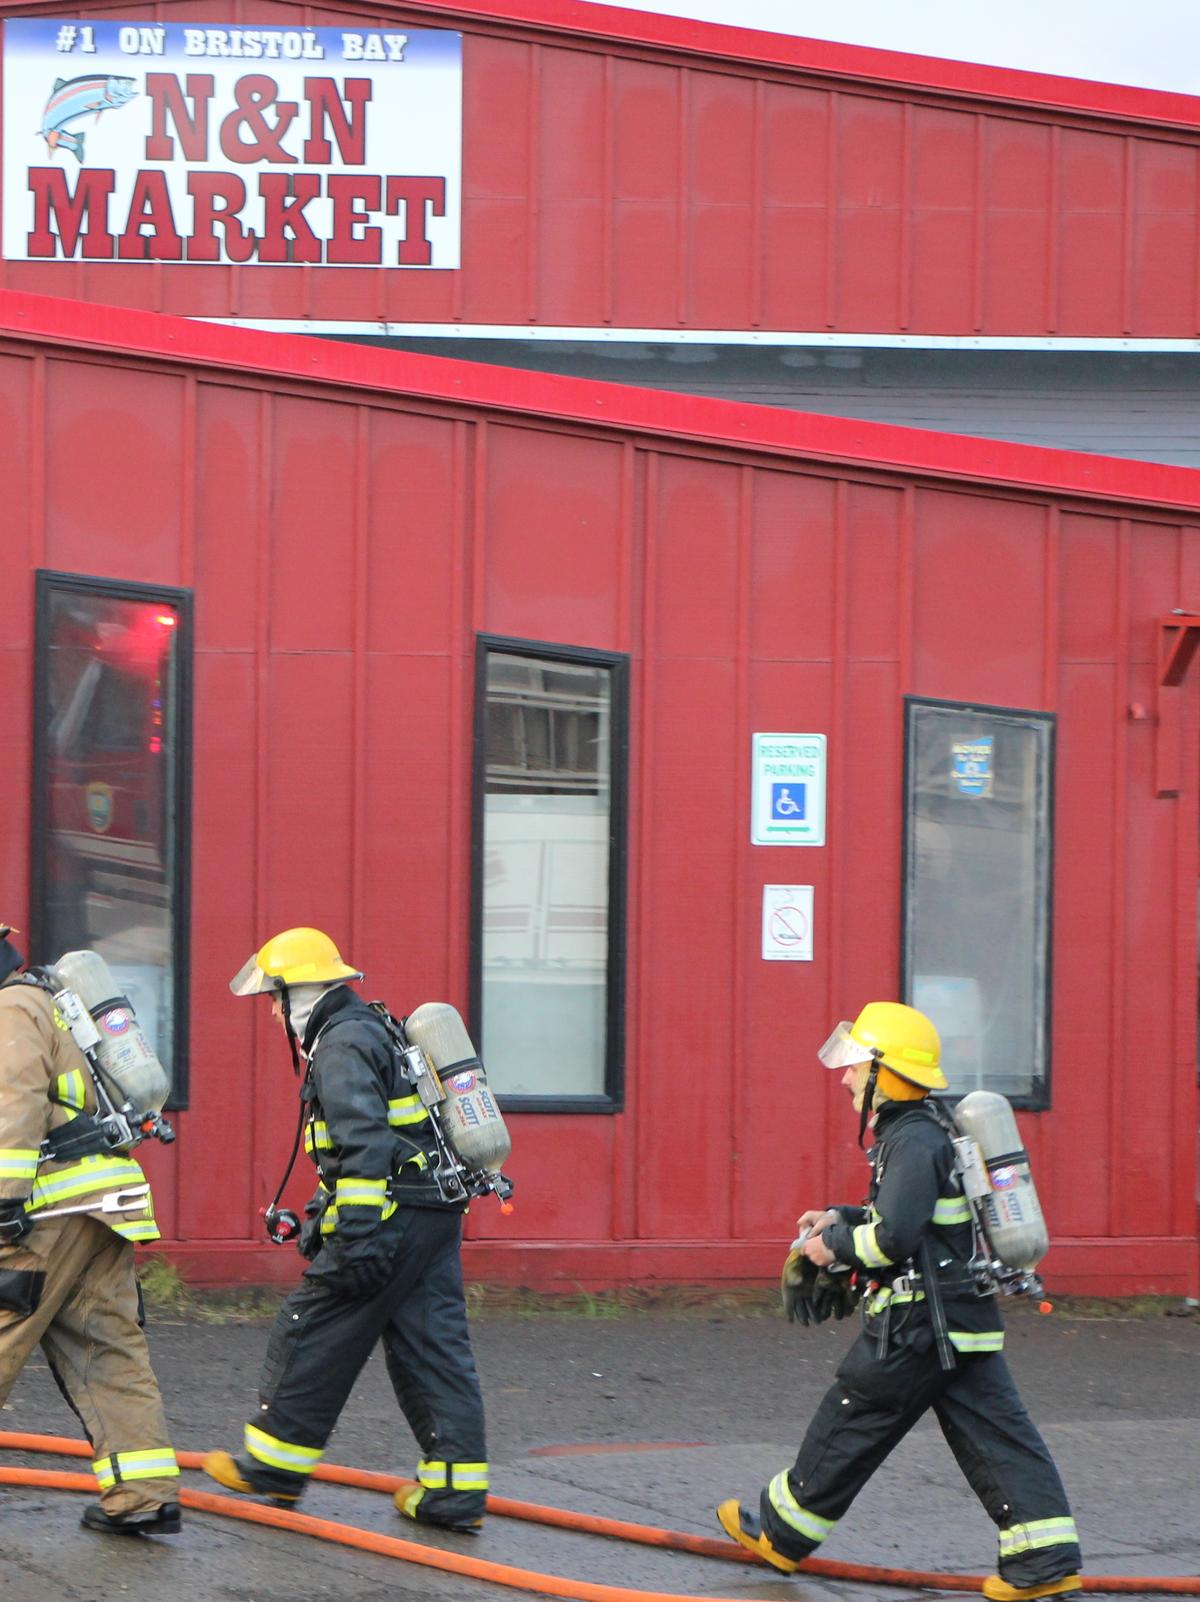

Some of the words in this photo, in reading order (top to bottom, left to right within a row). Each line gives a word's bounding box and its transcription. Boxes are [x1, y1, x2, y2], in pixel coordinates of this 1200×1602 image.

[56, 25, 96, 53] #1
[119, 27, 166, 55] ON
[183, 29, 324, 60] BRISTOL
[341, 33, 408, 62] BAY
[144, 72, 374, 166] N&N
[26, 165, 448, 265] MARKET
[760, 745, 821, 758] RESERVED
[763, 764, 815, 777] PARKING
[458, 1096, 480, 1125] SCOTT
[479, 1089, 498, 1120] SCOTT
[1007, 1191, 1023, 1222] SCOTT
